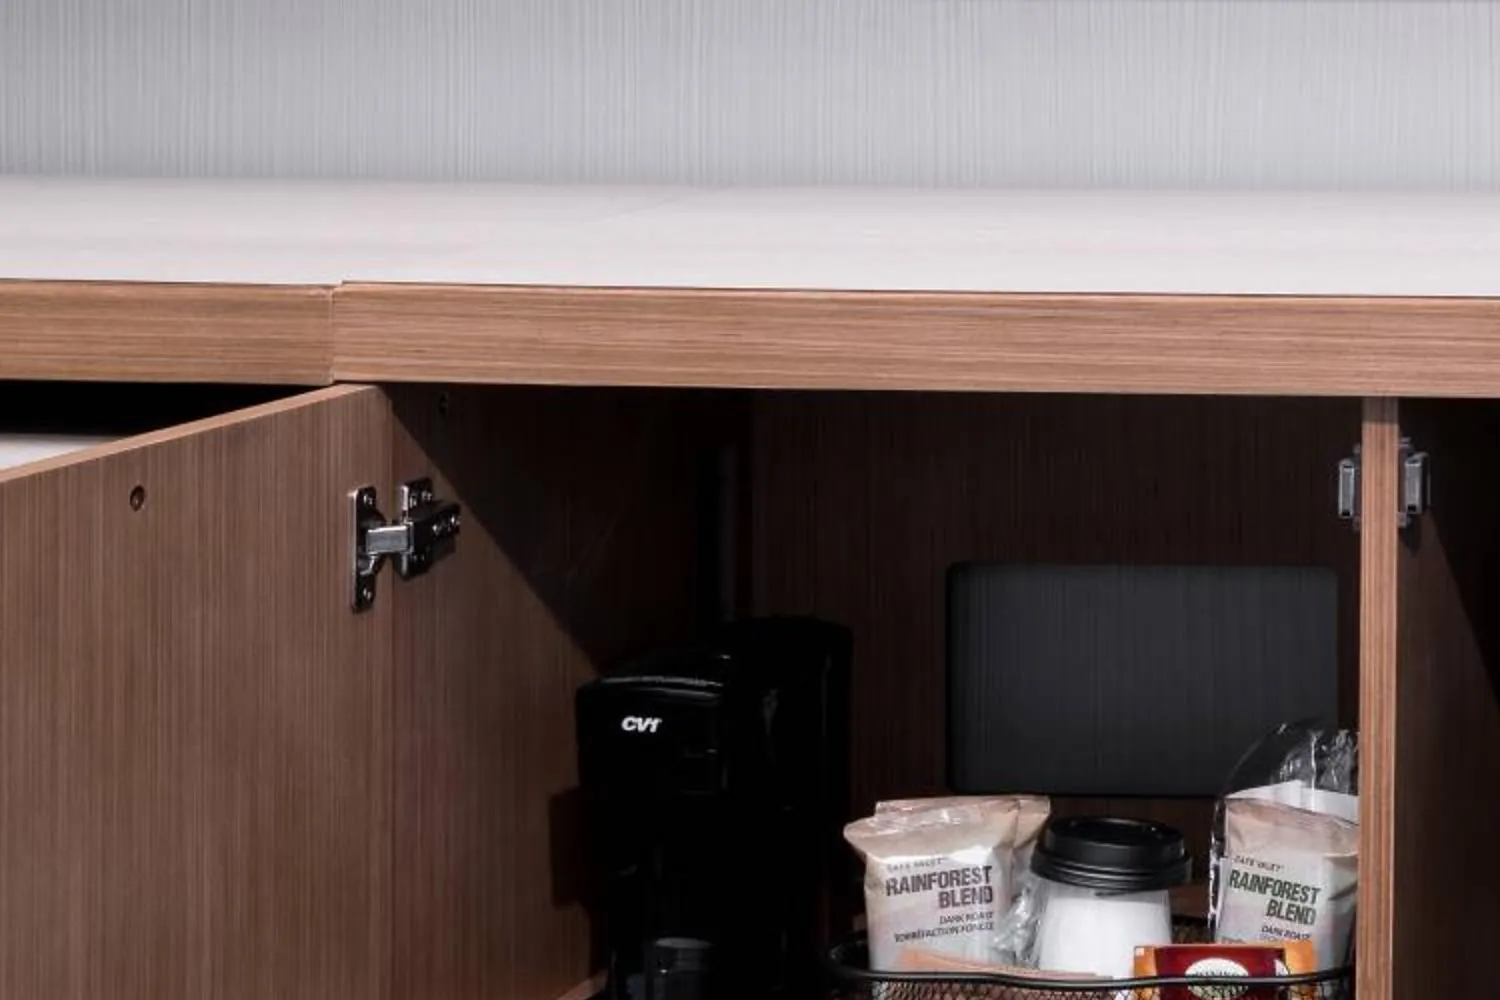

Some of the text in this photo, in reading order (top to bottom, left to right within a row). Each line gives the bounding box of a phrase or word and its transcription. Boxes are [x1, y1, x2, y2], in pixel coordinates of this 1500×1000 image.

[885, 865, 993, 897] RAINFOREST
[1229, 869, 1321, 905] RAINFOREST
[939, 885, 993, 909] BLEND
[1265, 898, 1317, 926] BLEND
